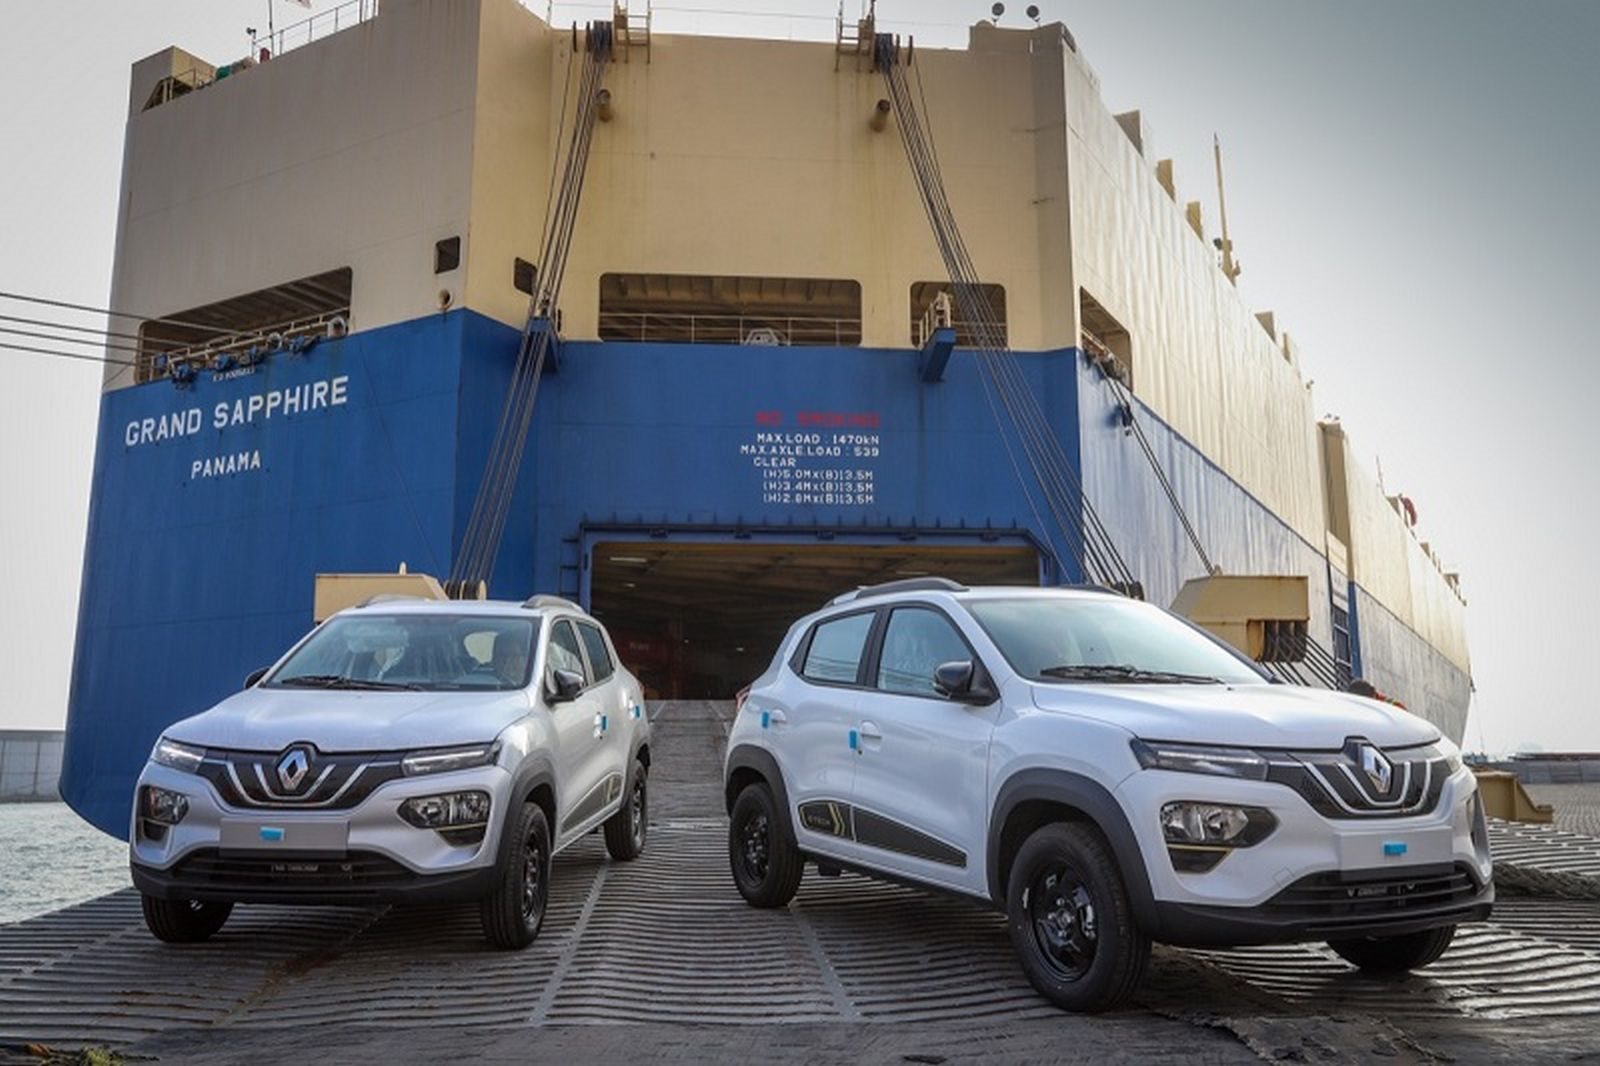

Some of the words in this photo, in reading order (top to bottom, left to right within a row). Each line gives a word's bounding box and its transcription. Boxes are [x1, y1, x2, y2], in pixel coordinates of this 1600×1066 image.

[125, 408, 202, 447] GRAND
[213, 376, 349, 429] SAPPHIRE
[190, 450, 261, 480] PANAMA
[753, 456, 796, 467] CLEAR
